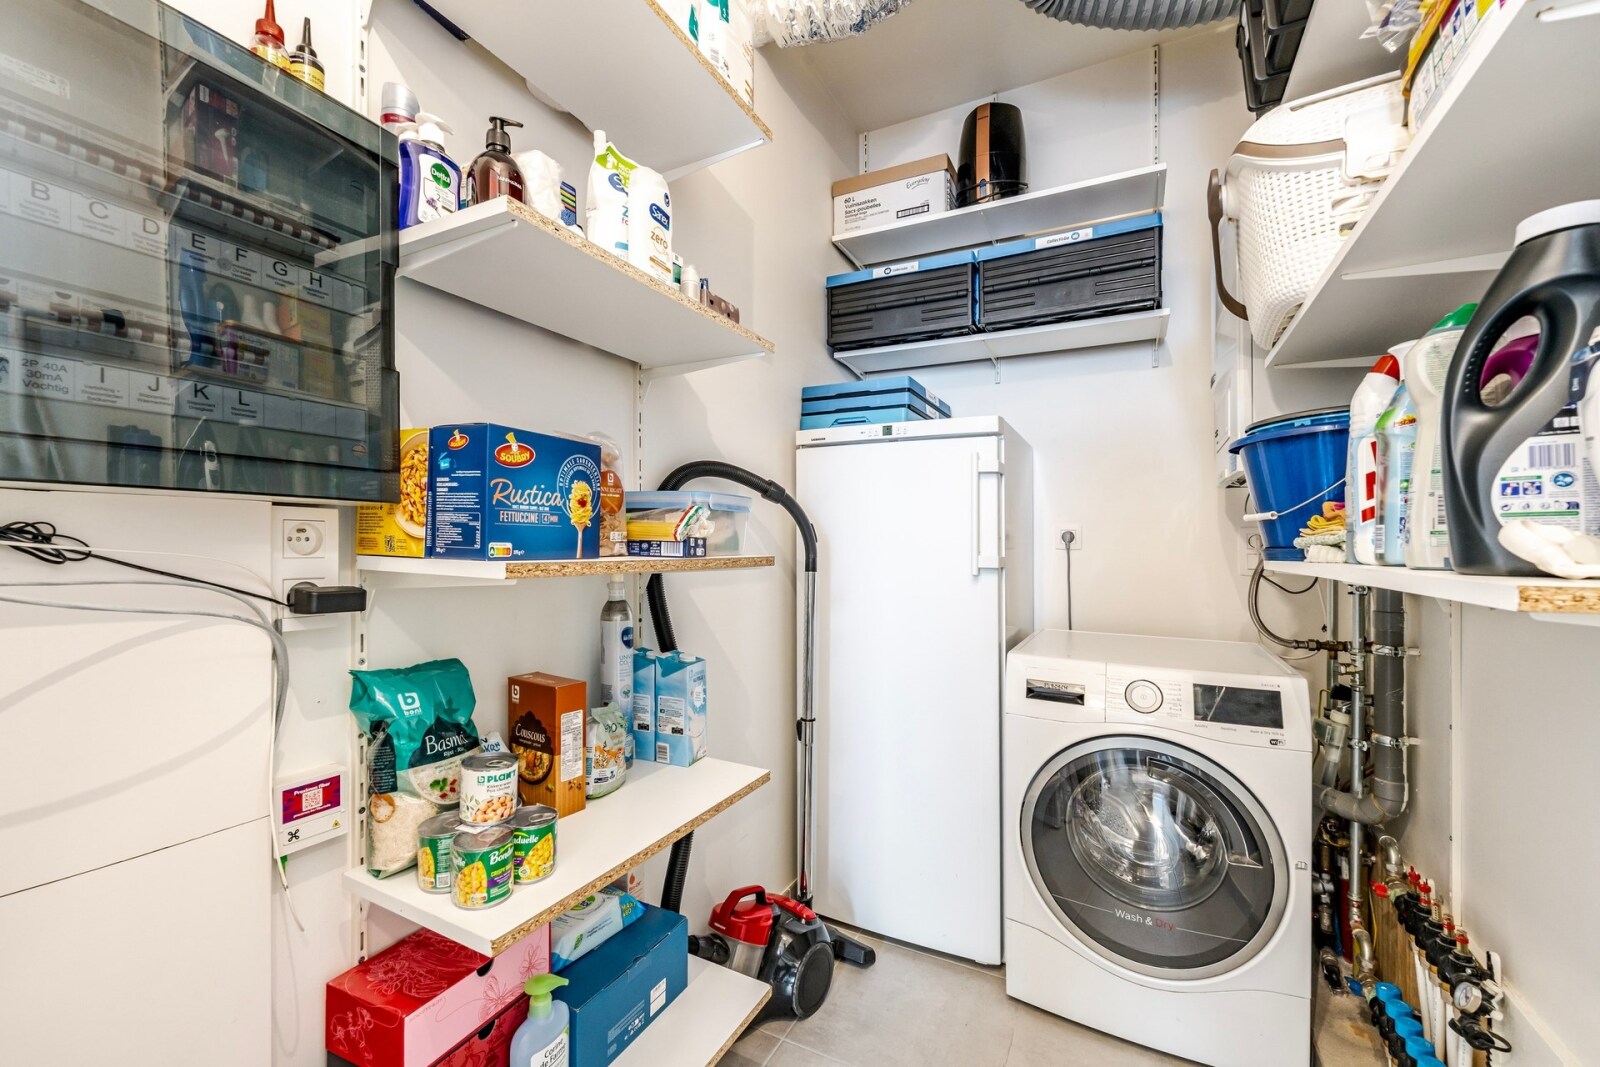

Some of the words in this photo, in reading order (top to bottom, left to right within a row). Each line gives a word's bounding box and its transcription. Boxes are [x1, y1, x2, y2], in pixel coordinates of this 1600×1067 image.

[431, 167, 451, 184] Dettol
[905, 176, 931, 190] Everyday
[31, 181, 51, 201] B
[89, 201, 109, 219] C
[143, 217, 160, 235] D
[192, 233, 207, 251] E
[650, 230, 669, 250] zero
[235, 247, 249, 262] F
[273, 261, 288, 276] G
[310, 272, 322, 288] H
[22, 359, 40, 367] 2P
[43, 362, 68, 373] 40A
[26, 368, 63, 382] 30mA
[22, 379, 69, 395] Vochtig
[148, 377, 160, 391] J
[194, 383, 210, 400] K
[238, 390, 250, 407] L
[499, 452, 531, 464] SOUBRY
[490, 478, 565, 507] Rustica
[499, 511, 539, 524] FETTUCCINE
[403, 708, 423, 717] boni
[515, 723, 546, 743] Couscous
[1115, 908, 1143, 923] Wash
[1145, 916, 1153, 927] &
[1155, 918, 1173, 932] Dry
[544, 1038, 564, 1059] Corine
[551, 1043, 567, 1063] Farme
